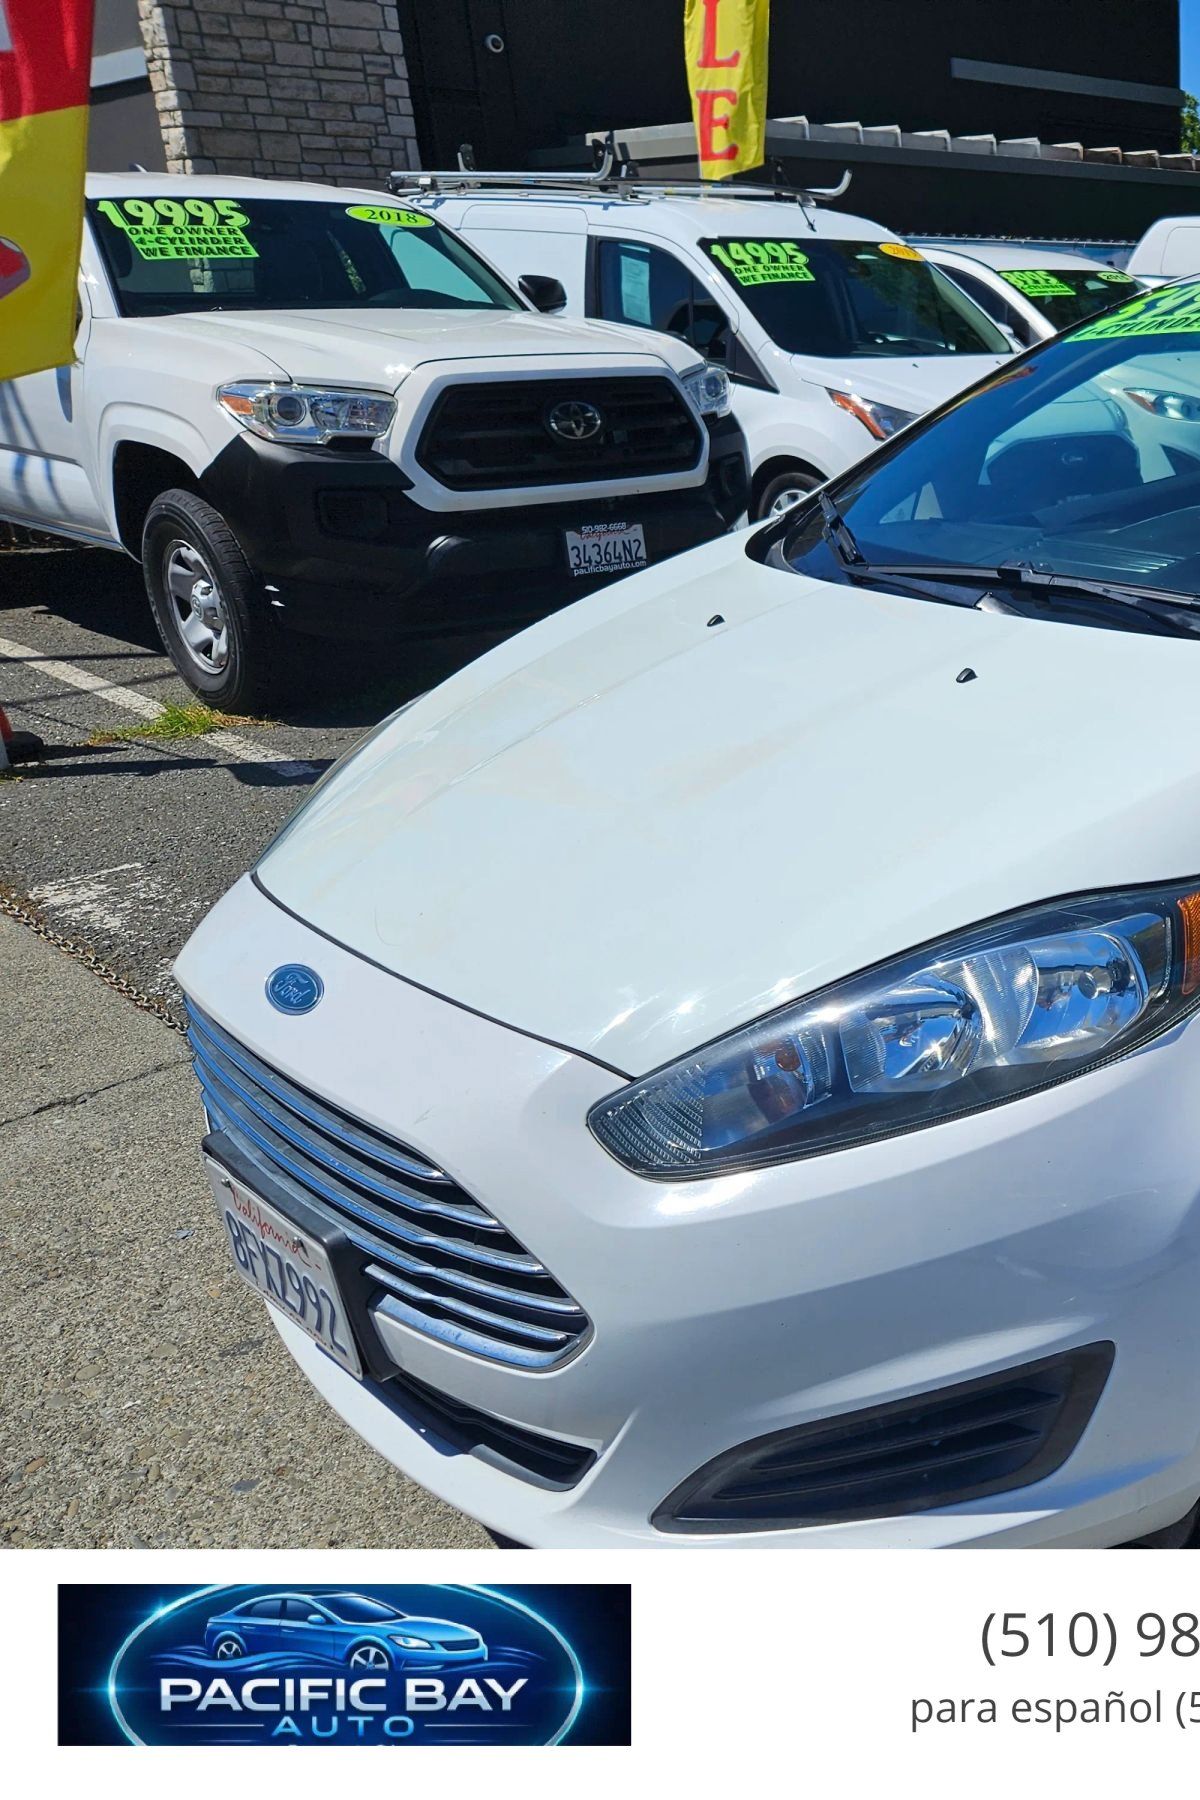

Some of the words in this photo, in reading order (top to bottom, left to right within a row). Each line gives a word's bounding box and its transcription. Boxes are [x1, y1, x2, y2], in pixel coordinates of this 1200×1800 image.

[97, 199, 250, 228] 19995
[364, 209, 418, 224] 2018
[128, 227, 167, 236] ONE
[173, 226, 241, 236] OWNER
[135, 236, 246, 245] 4-CYLINDER
[140, 247, 170, 257] WE
[175, 246, 251, 256] FINANCE
[711, 242, 810, 267] 14995
[734, 265, 760, 274] ONE
[763, 264, 805, 273] OWNER
[739, 275, 758, 284] WE
[762, 273, 810, 281] FINANCE
[570, 539, 644, 567] 34364N2
[573, 560, 647, 577] pacificbayauto.com
[274, 973, 311, 1004] Ford
[226, 1210, 347, 1356] 8FXZ992
